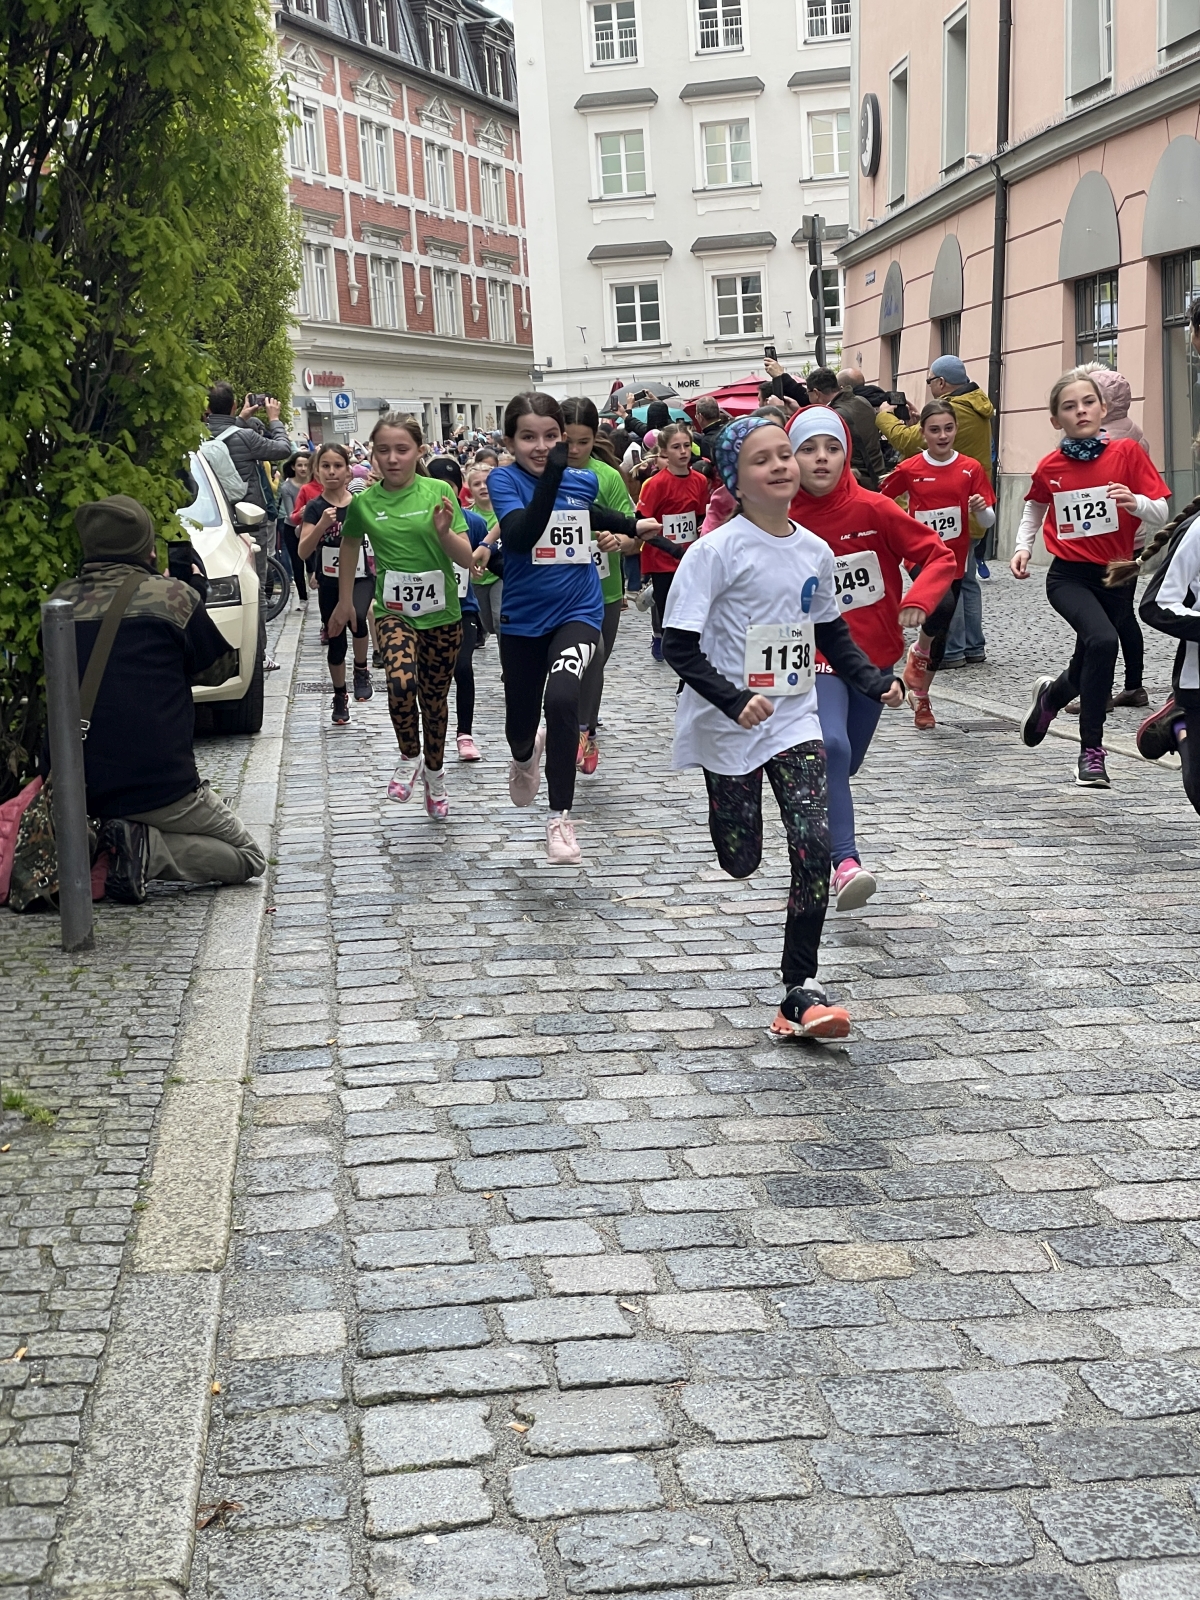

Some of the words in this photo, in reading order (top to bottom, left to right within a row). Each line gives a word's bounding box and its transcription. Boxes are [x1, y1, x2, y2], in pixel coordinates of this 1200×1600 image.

[677, 379, 701, 388] MORE
[1062, 500, 1108, 523] 1123
[550, 526, 584, 546] 651
[669, 520, 694, 534] 1120
[392, 583, 436, 602] 1374
[761, 642, 811, 671] 1138
